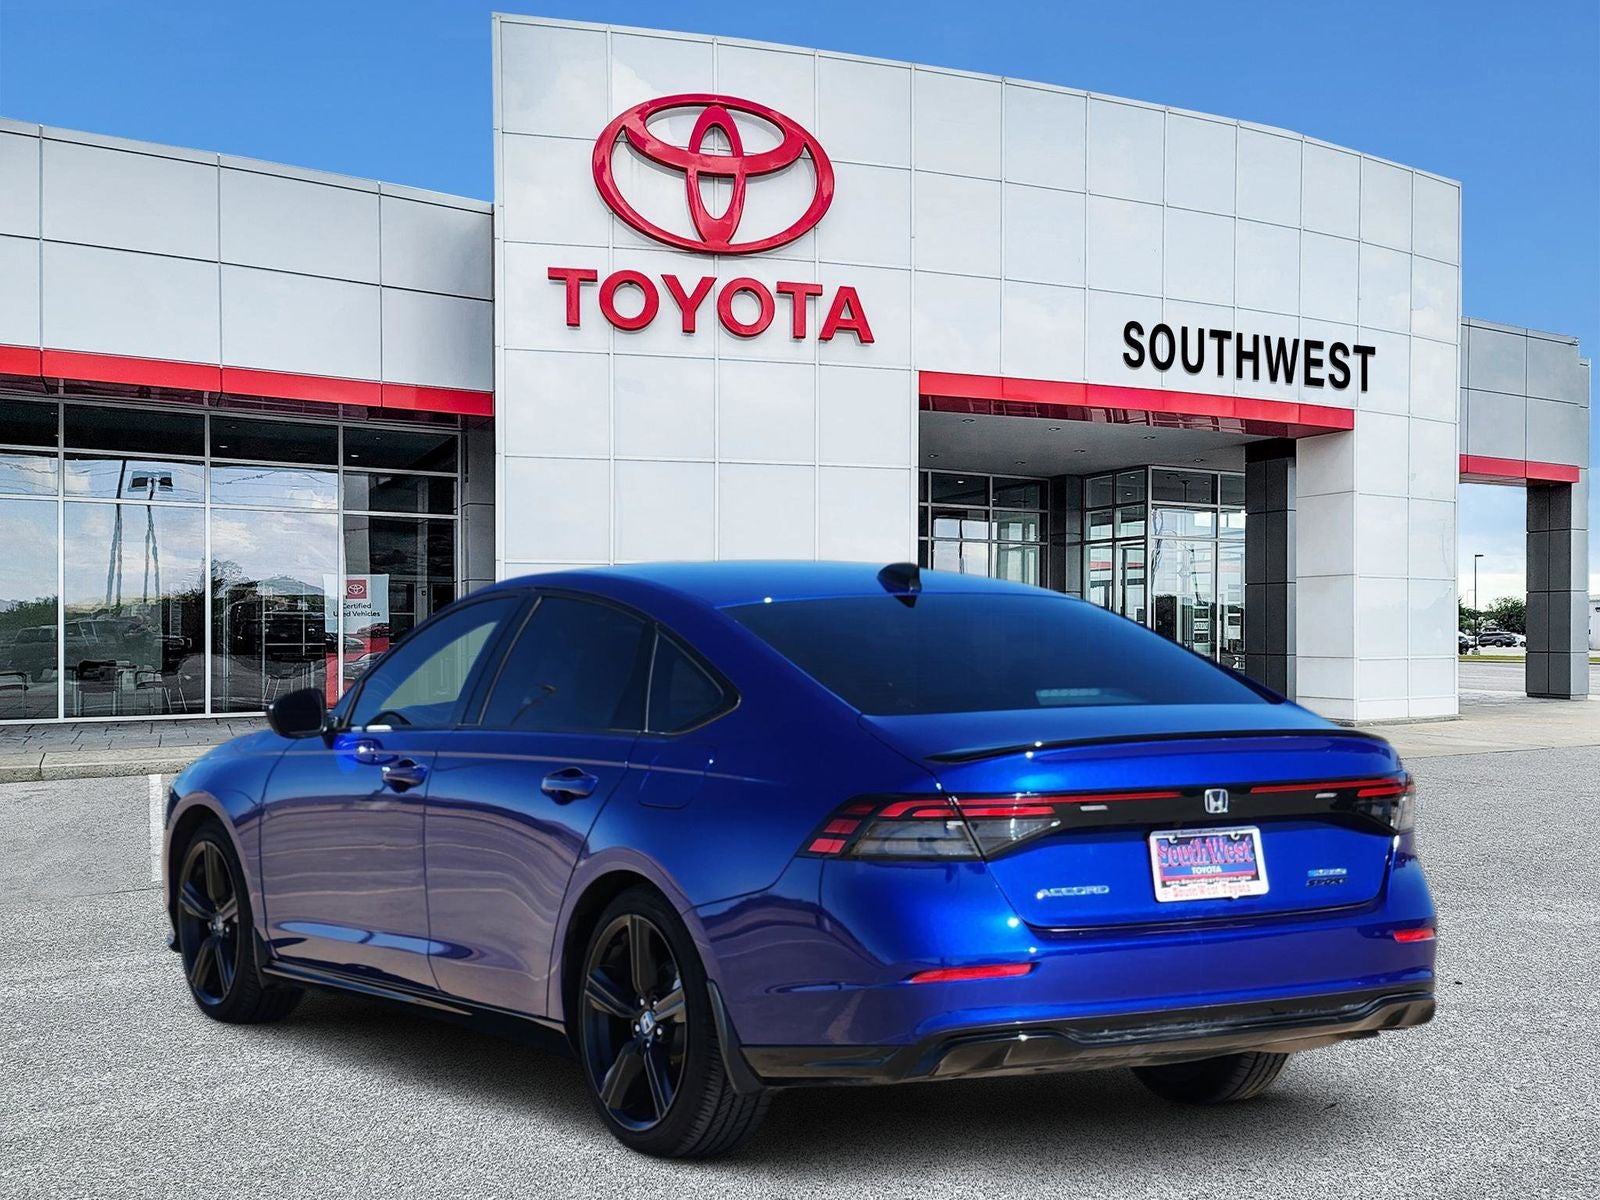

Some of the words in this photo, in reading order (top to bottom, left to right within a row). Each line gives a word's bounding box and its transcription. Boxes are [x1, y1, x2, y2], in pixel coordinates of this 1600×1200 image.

[547, 266, 875, 344] TOYOTA
[1122, 320, 1376, 392] SOUTHWEST
[343, 602, 372, 610] Certified
[1191, 865, 1223, 875] TOYOTA
[1036, 885, 1110, 900] ACCORD
